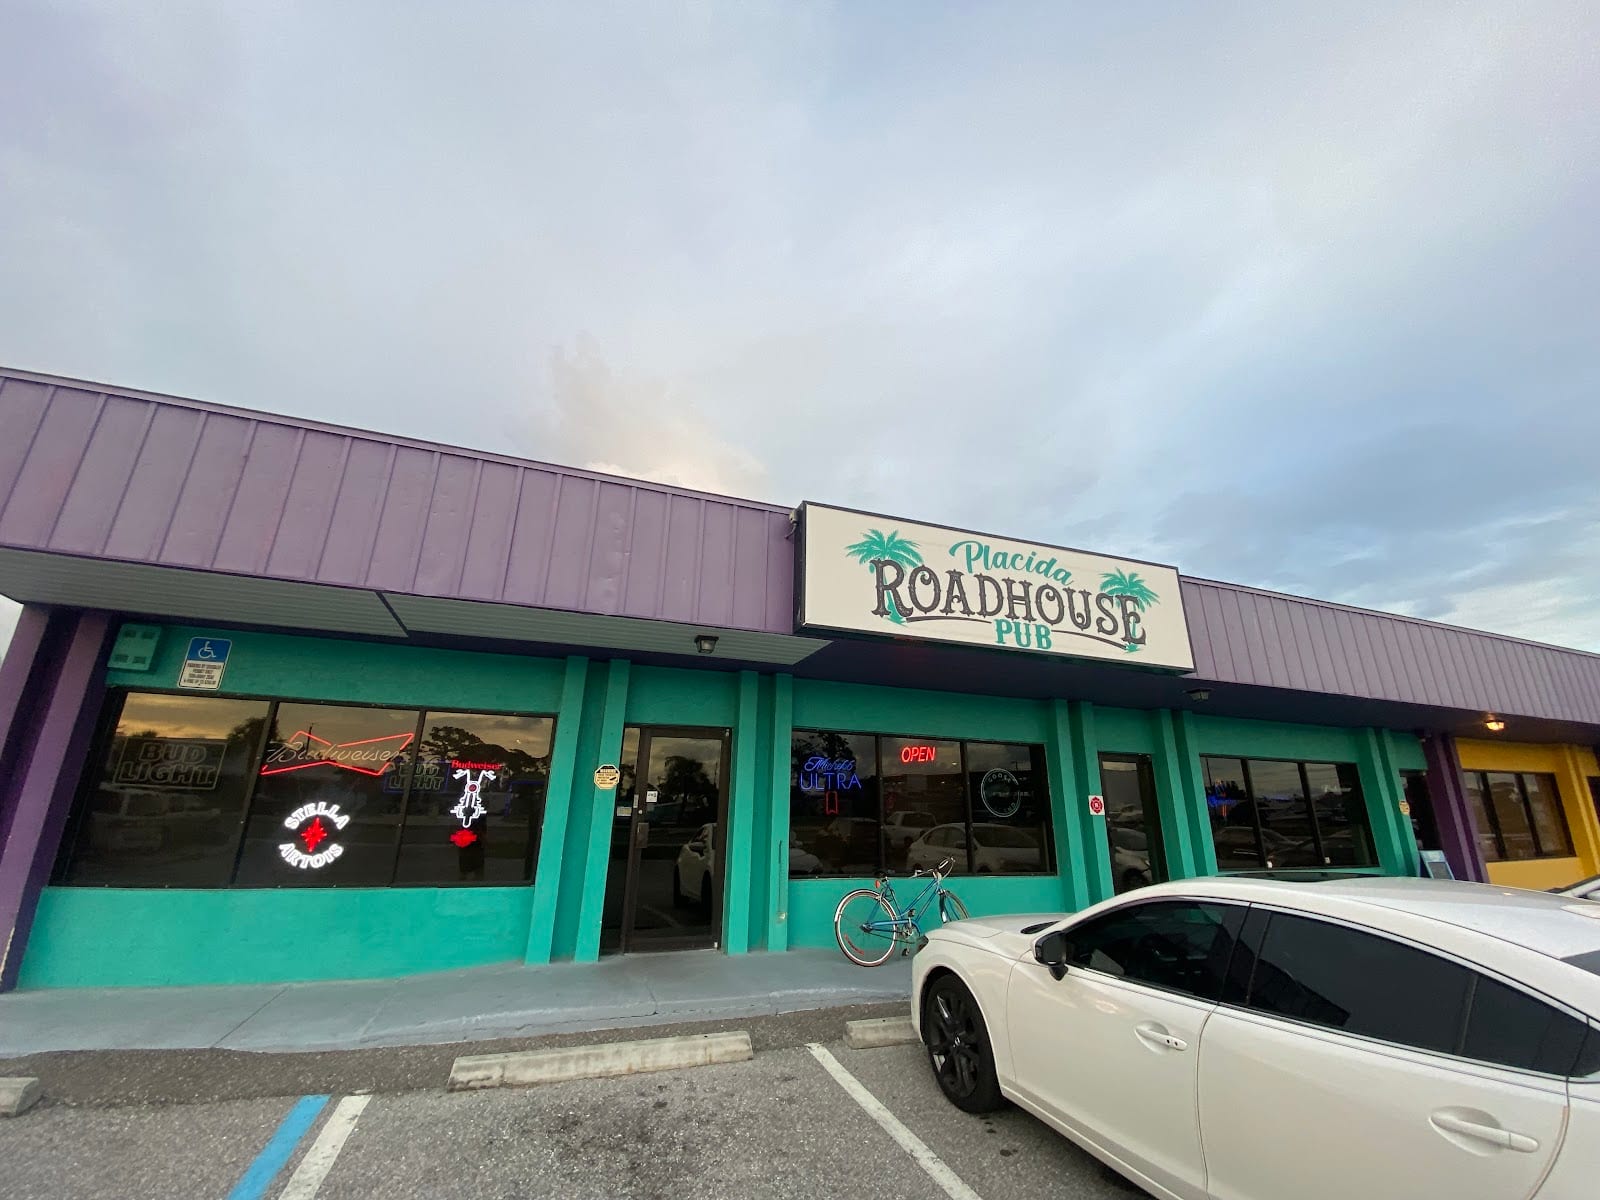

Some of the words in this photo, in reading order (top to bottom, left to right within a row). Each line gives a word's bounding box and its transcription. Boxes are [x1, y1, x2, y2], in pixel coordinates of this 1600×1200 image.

[949, 540, 1073, 586] Placida
[869, 557, 1147, 646] ROADHOUSE
[994, 618, 1052, 650] PUB
[139, 742, 207, 765] BUD
[266, 740, 402, 763] Budweiser
[901, 746, 936, 762] OPEN
[119, 761, 217, 785] LIGHT
[451, 759, 503, 770] Budweiser
[800, 772, 862, 790] ULTRA
[284, 801, 350, 830] STELLA
[278, 842, 344, 869] ARTOIS
